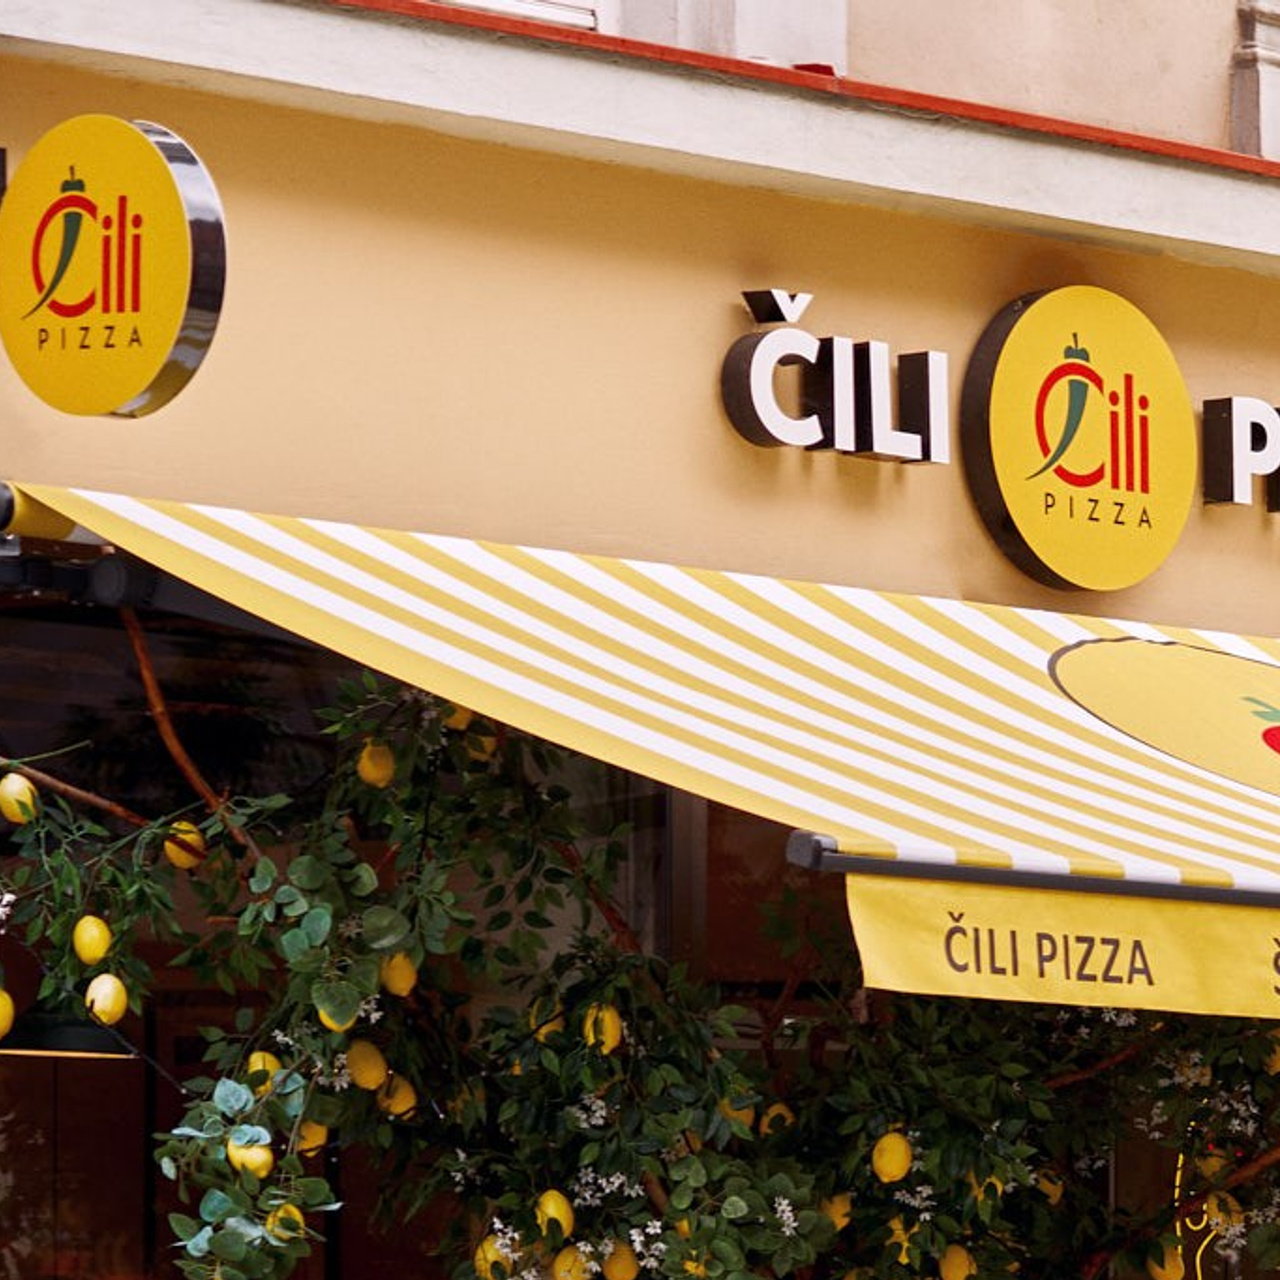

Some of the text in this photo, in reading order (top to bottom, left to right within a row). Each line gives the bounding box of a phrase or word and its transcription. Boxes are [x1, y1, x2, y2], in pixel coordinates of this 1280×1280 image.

[38, 326, 142, 350] PIZZA
[750, 288, 951, 465] ČILI
[1045, 492, 1153, 529] PIZZA
[946, 911, 1019, 977] ČILI
[1036, 932, 1154, 986] PIZZA
